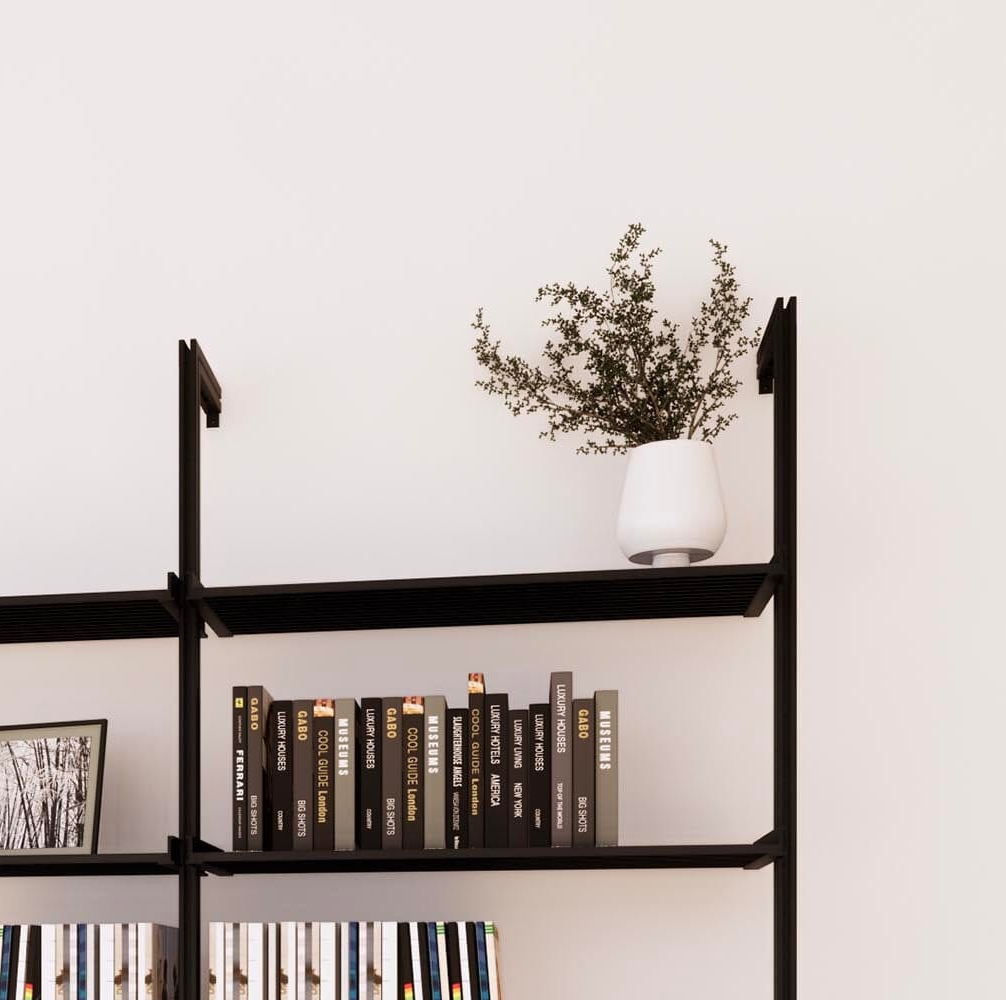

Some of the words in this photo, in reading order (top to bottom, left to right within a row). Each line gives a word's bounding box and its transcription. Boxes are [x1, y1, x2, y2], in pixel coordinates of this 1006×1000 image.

[557, 684, 566, 716] LUXURY
[277, 711, 286, 739] LUXURY
[298, 710, 307, 741] GABO
[366, 708, 375, 737] LUXURY
[386, 708, 397, 739] GABO
[490, 704, 500, 734] LUXURY
[514, 720, 522, 745] LUXURY
[535, 714, 543, 741] LUXURY
[578, 709, 589, 739] GABO
[318, 730, 328, 756] COOL
[338, 718, 348, 776] MUSEUMS
[407, 727, 418, 754] COOL
[428, 716, 439, 774] MUSEUMS
[453, 716, 462, 765] SLAUGHTERHOUSE
[490, 736, 500, 765] HOTELS
[557, 719, 566, 753] HOUSES
[600, 711, 611, 770] MUSEUMS
[277, 740, 286, 771] HOUSES
[366, 738, 375, 769] HOUSES
[514, 746, 522, 769] LIVING
[535, 743, 543, 771] HOUSES
[236, 750, 244, 801] FERRARI
[318, 759, 328, 787] GUIDE
[407, 756, 418, 785] GUIDE
[453, 766, 462, 787] ANGELS
[386, 798, 395, 811] BIG
[490, 773, 500, 807] AMERICA
[514, 782, 522, 798] NEW
[578, 797, 587, 811] BIG
[298, 800, 306, 812] BIG
[318, 790, 328, 823] London
[407, 789, 418, 822] London
[514, 799, 522, 818] YORK
[298, 814, 306, 837] SHOTS
[386, 813, 395, 836] SHOTS
[578, 813, 587, 833] SHOTS
